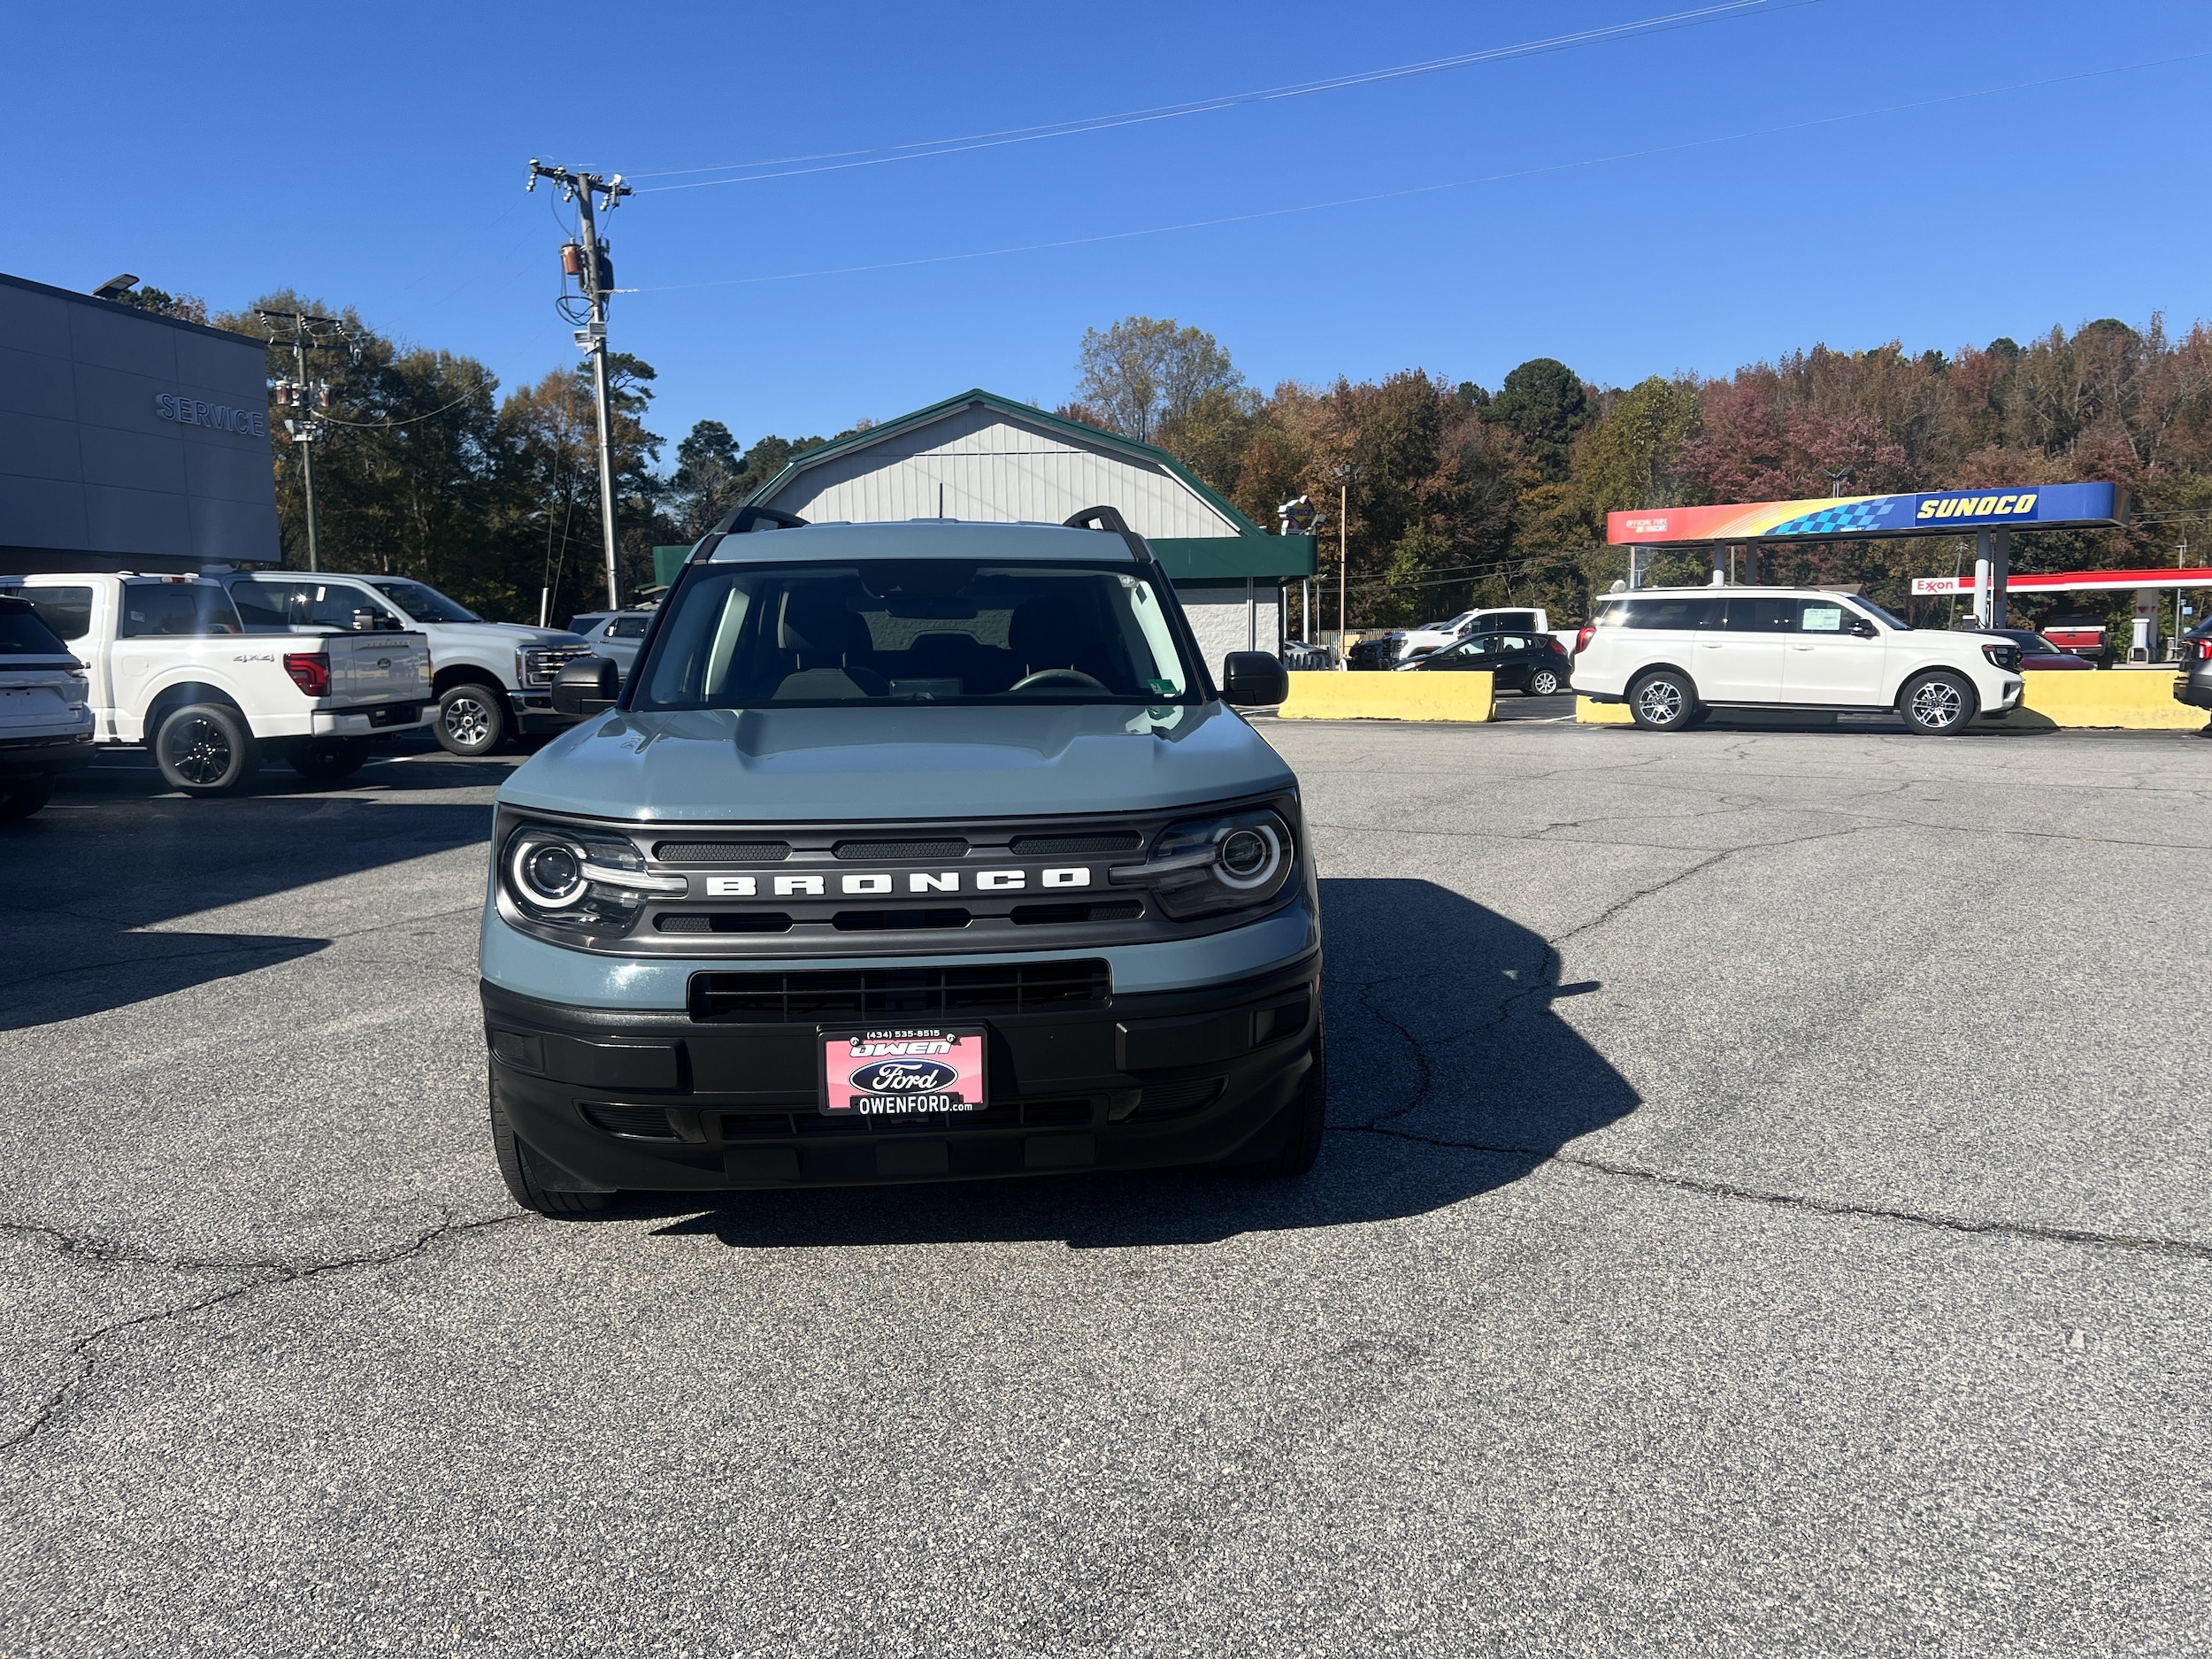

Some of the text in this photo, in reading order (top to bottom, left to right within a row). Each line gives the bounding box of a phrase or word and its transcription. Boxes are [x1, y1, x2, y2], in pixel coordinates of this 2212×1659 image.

[157, 393, 265, 437] SERVICE
[1916, 494, 2038, 519] SUNOCO
[1917, 580, 1954, 593] Exxon
[707, 867, 1091, 896] BRONCO
[866, 1029, 941, 1040] (434) 535-8515
[872, 1064, 940, 1090] Ford
[859, 1094, 973, 1115] OWENFORD.com
